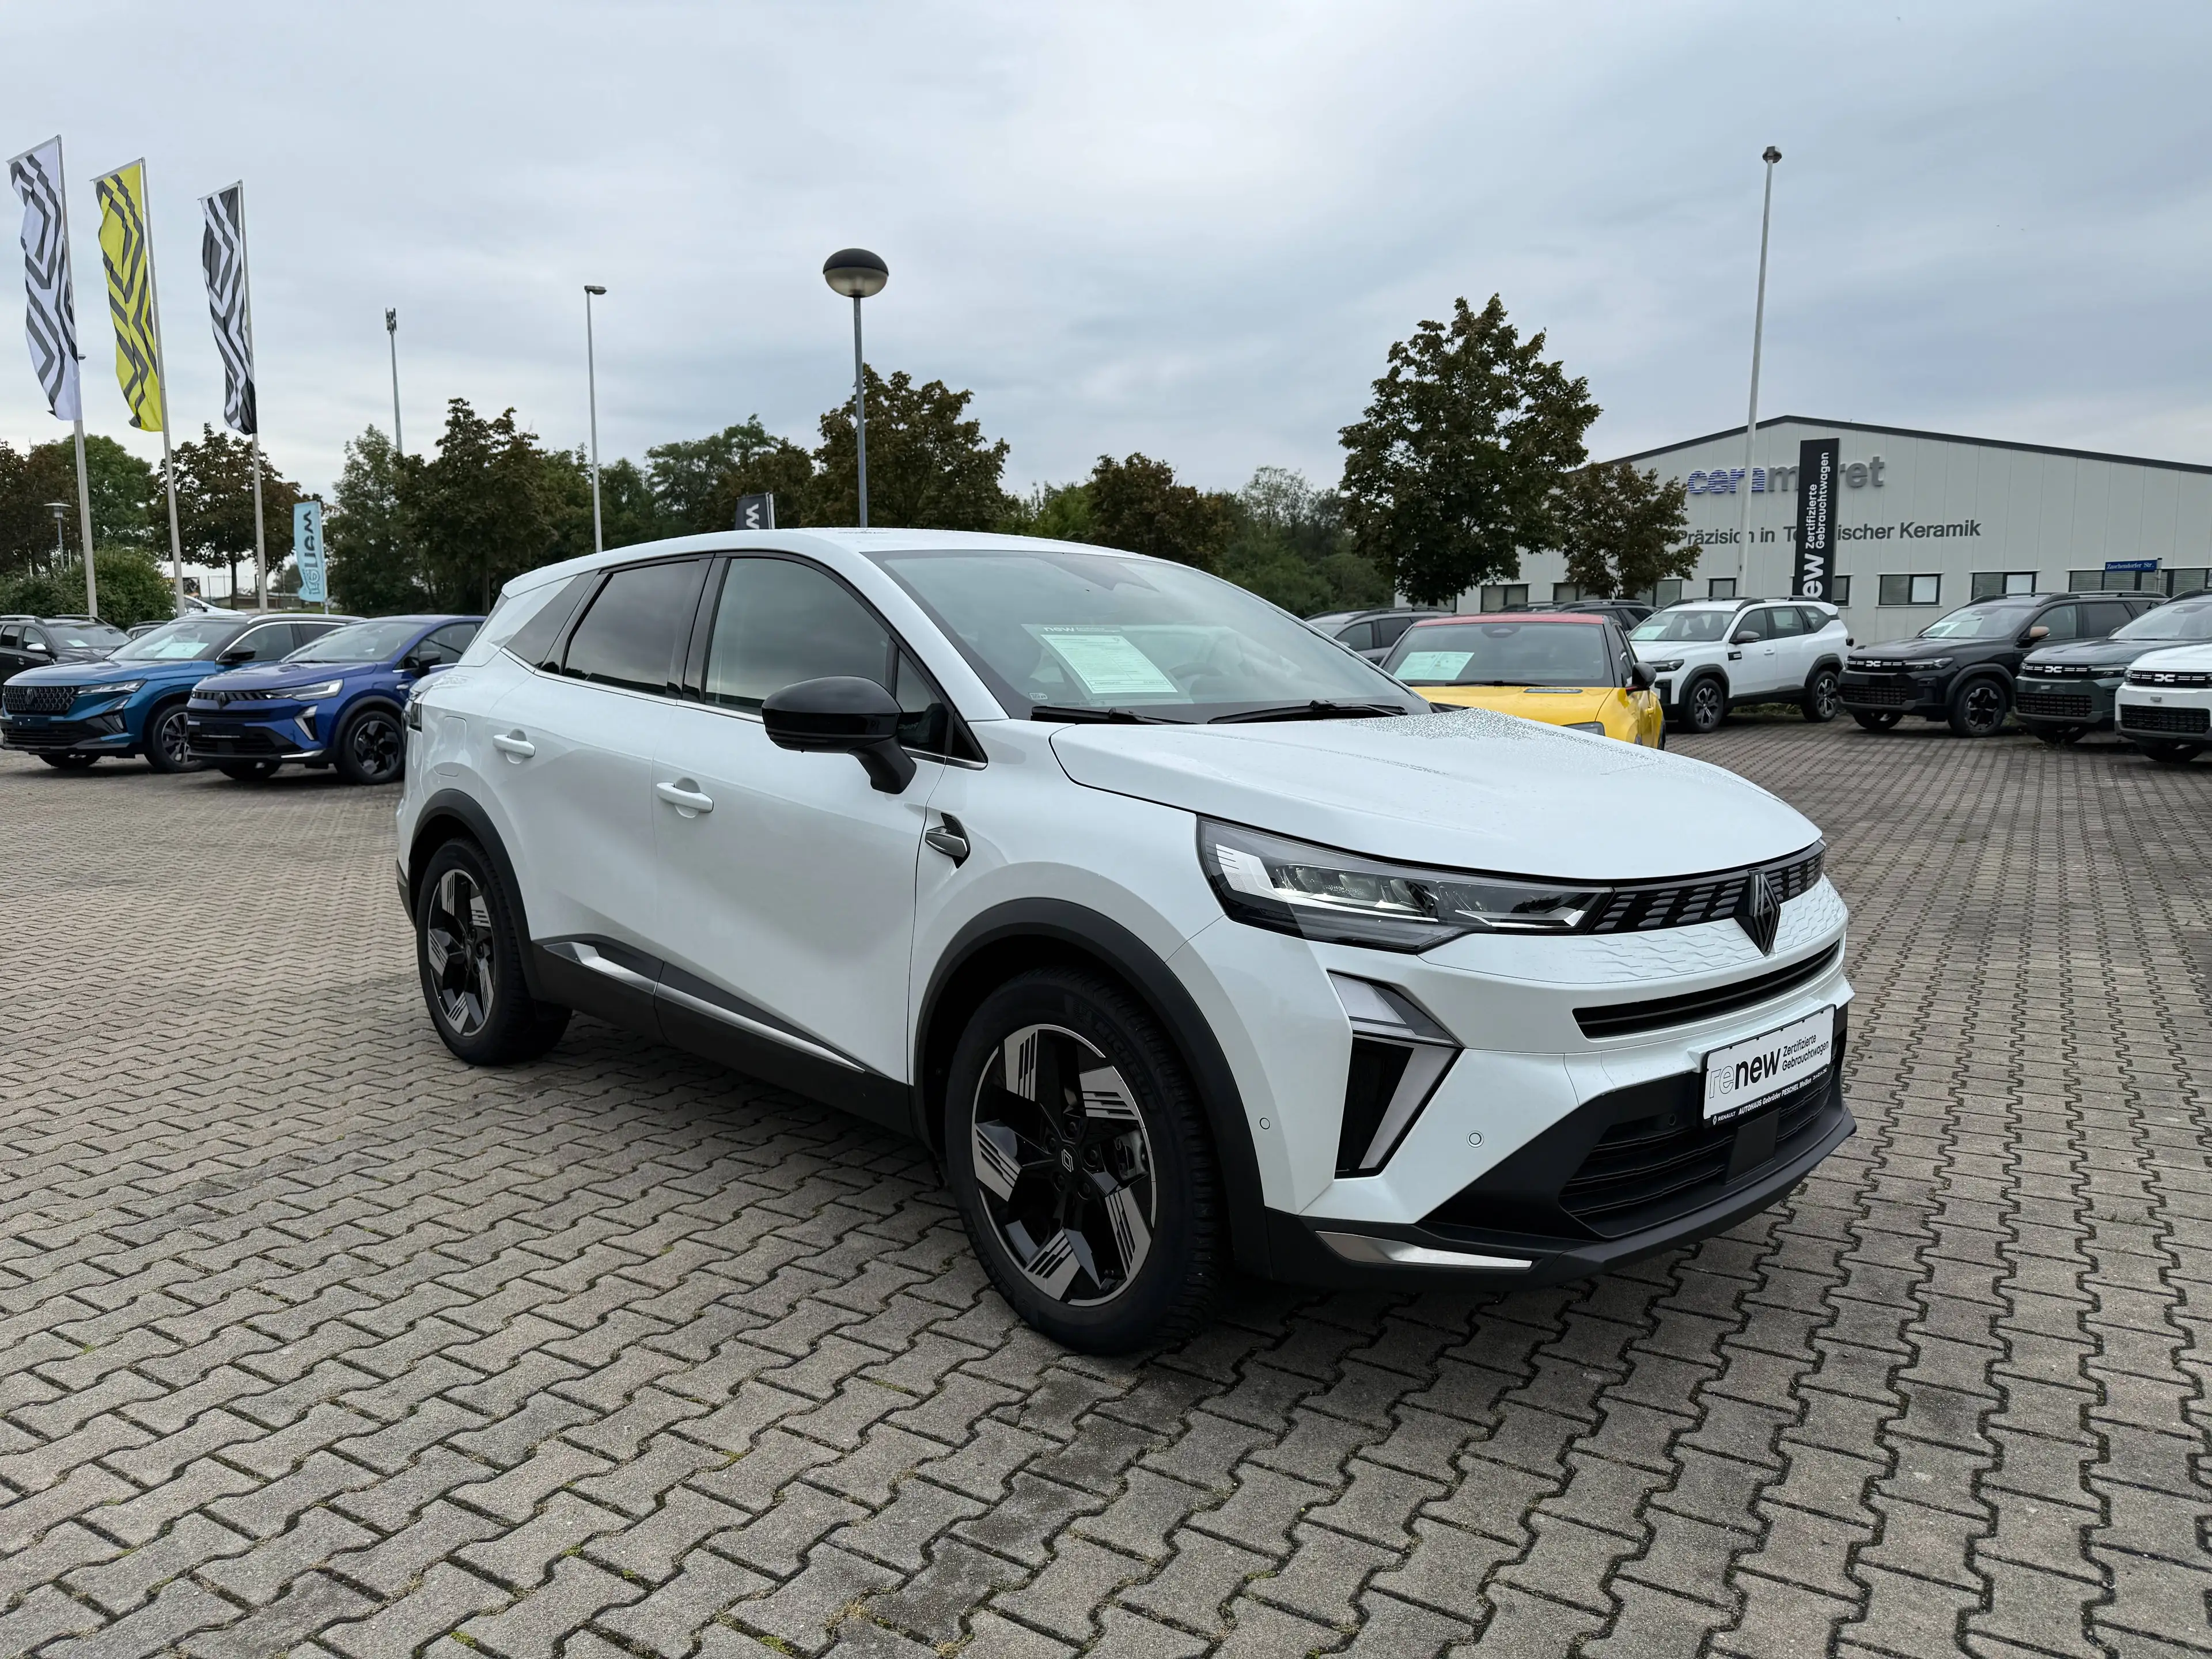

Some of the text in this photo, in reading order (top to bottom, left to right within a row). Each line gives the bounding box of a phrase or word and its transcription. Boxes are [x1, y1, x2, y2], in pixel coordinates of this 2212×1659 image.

[1688, 456, 1885, 494] ceramet
[1805, 484, 1817, 549] Zertifizierte
[1816, 452, 1831, 549] Gebrauchtwagen
[1760, 527, 1775, 543] in
[1783, 523, 1895, 542] Tischer
[1899, 520, 1982, 539] Keramik
[1782, 1040, 1829, 1071] Gebrauchtwagen
[1783, 1034, 1816, 1057] Zertifizierte
[1709, 1048, 1781, 1099] renew
[1718, 1111, 1736, 1122] RENAULT
[1738, 1099, 1762, 1116] AUTOHAUS
[1762, 1092, 1781, 1105] Gebrüder
[1781, 1085, 1799, 1096] PESCHEL
